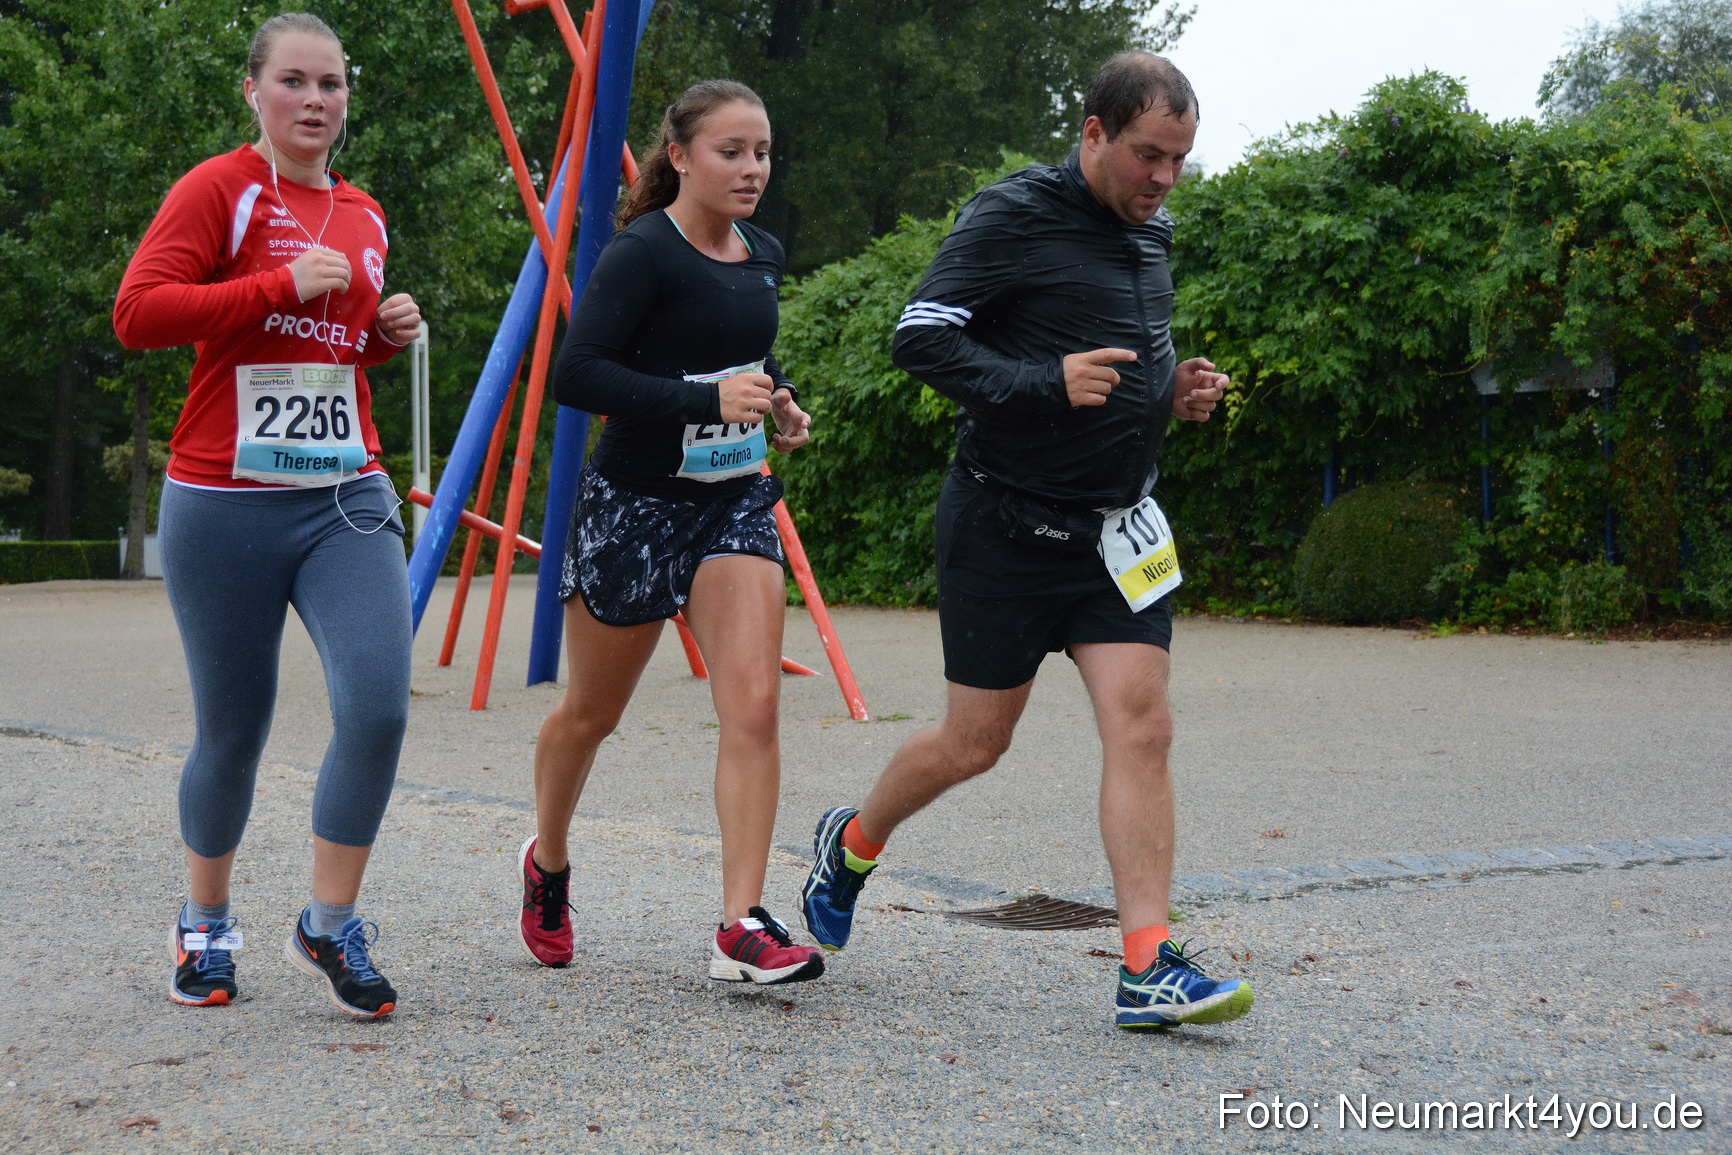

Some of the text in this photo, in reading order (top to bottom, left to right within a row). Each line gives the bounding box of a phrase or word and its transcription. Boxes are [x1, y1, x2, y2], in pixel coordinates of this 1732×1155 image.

[249, 378, 295, 387] NeuerMarkt
[254, 395, 351, 441] 2256
[273, 451, 339, 470] Theresa
[1046, 528, 1071, 541] asics
